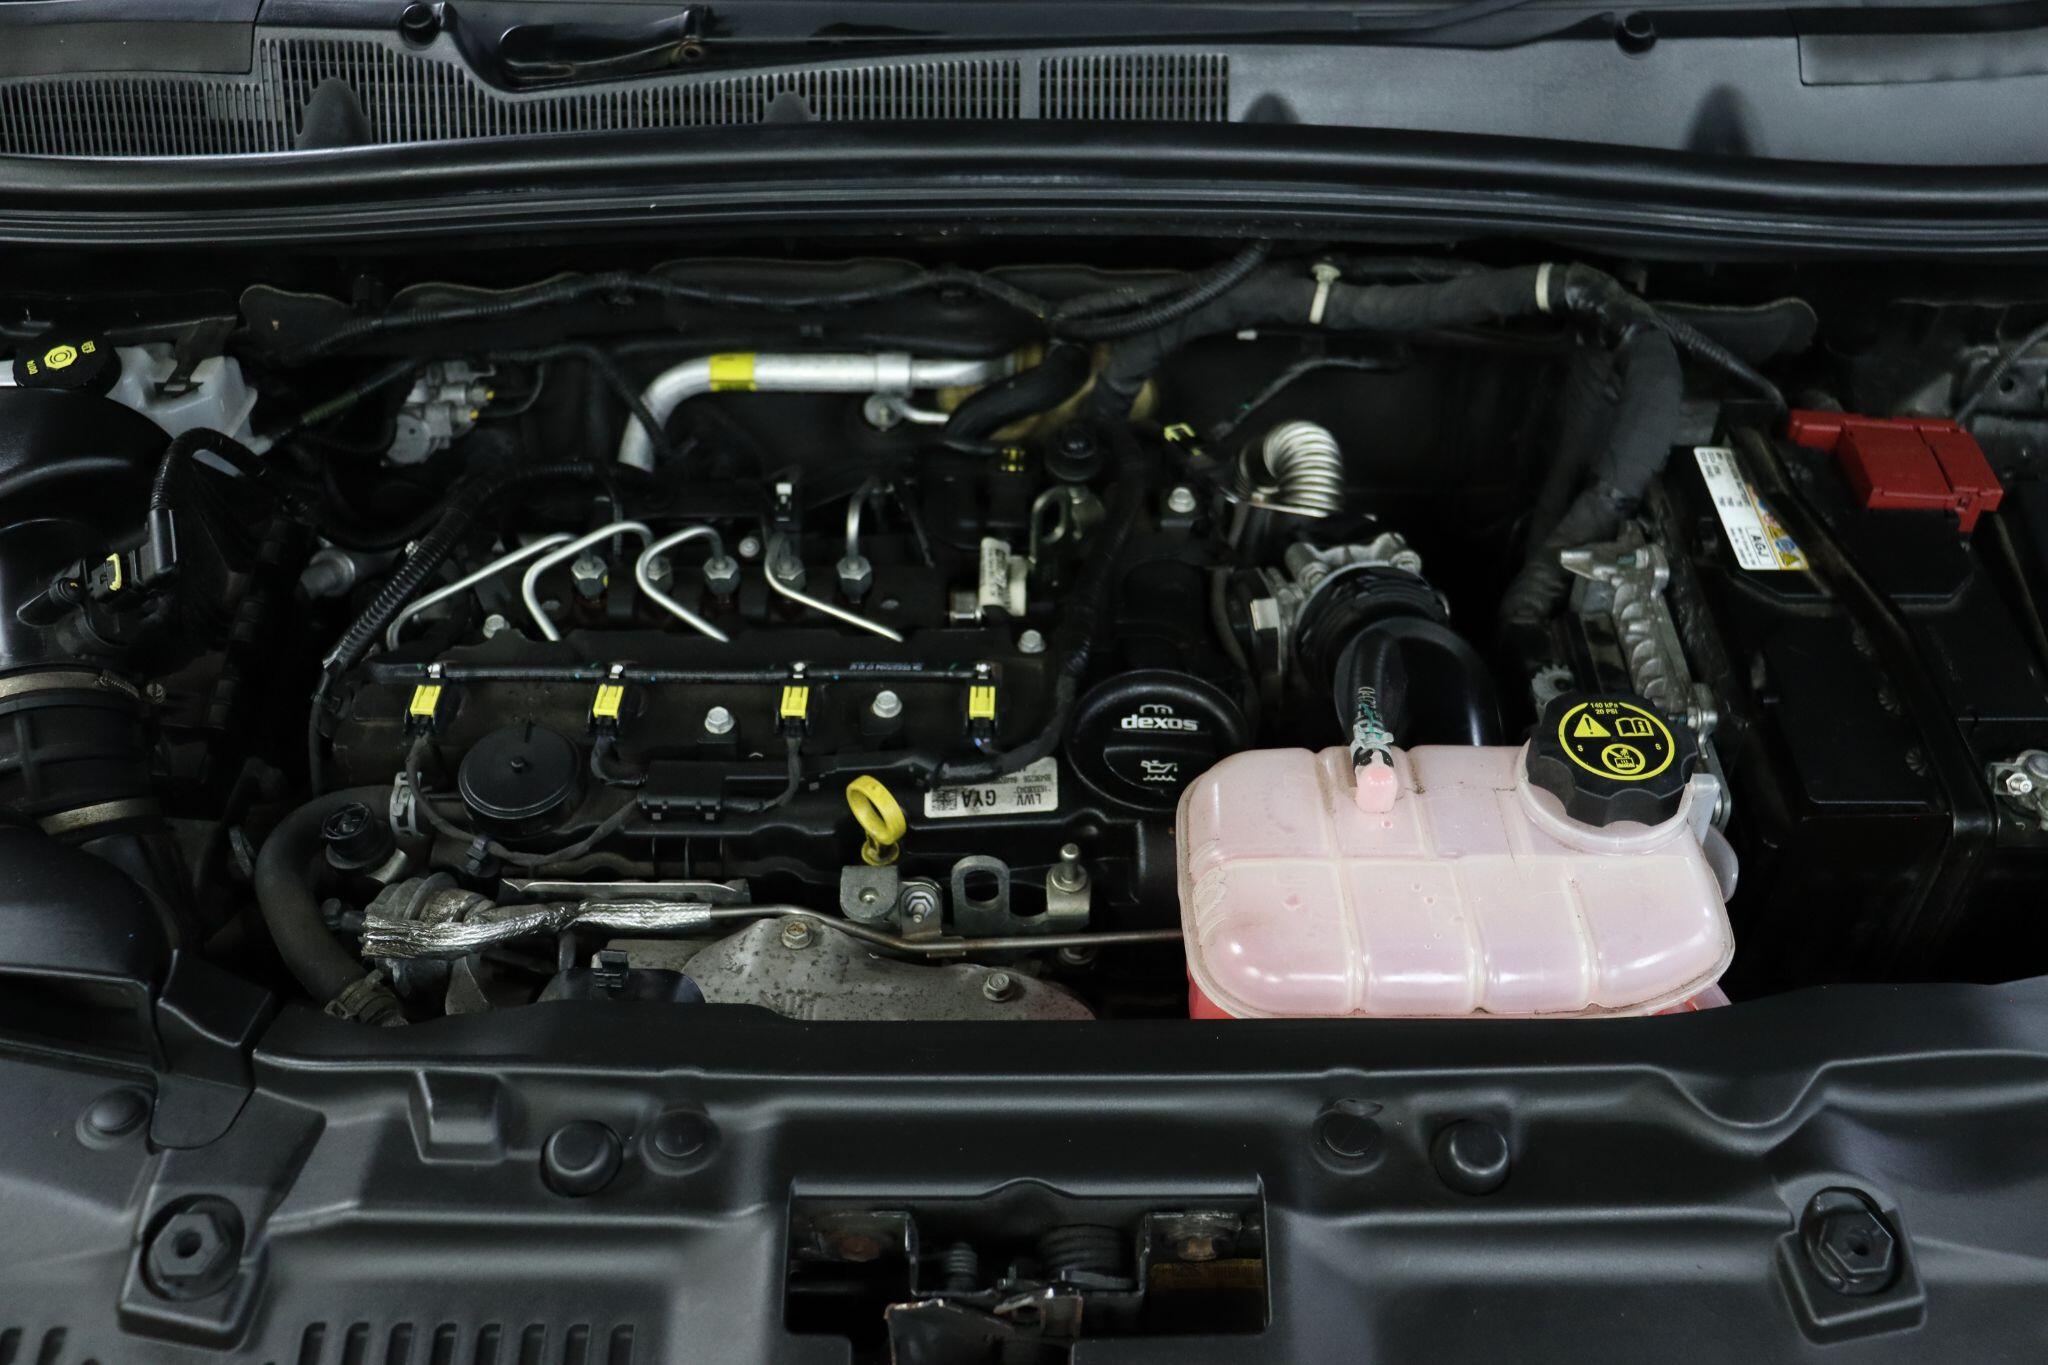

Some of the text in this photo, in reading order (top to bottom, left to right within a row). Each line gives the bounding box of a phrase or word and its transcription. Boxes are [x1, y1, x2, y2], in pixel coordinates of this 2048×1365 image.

[1751, 534, 1767, 557] AGJ
[1121, 714, 1198, 731] dexos
[962, 790, 996, 808] GYA
[1016, 793, 1042, 806] LWV
